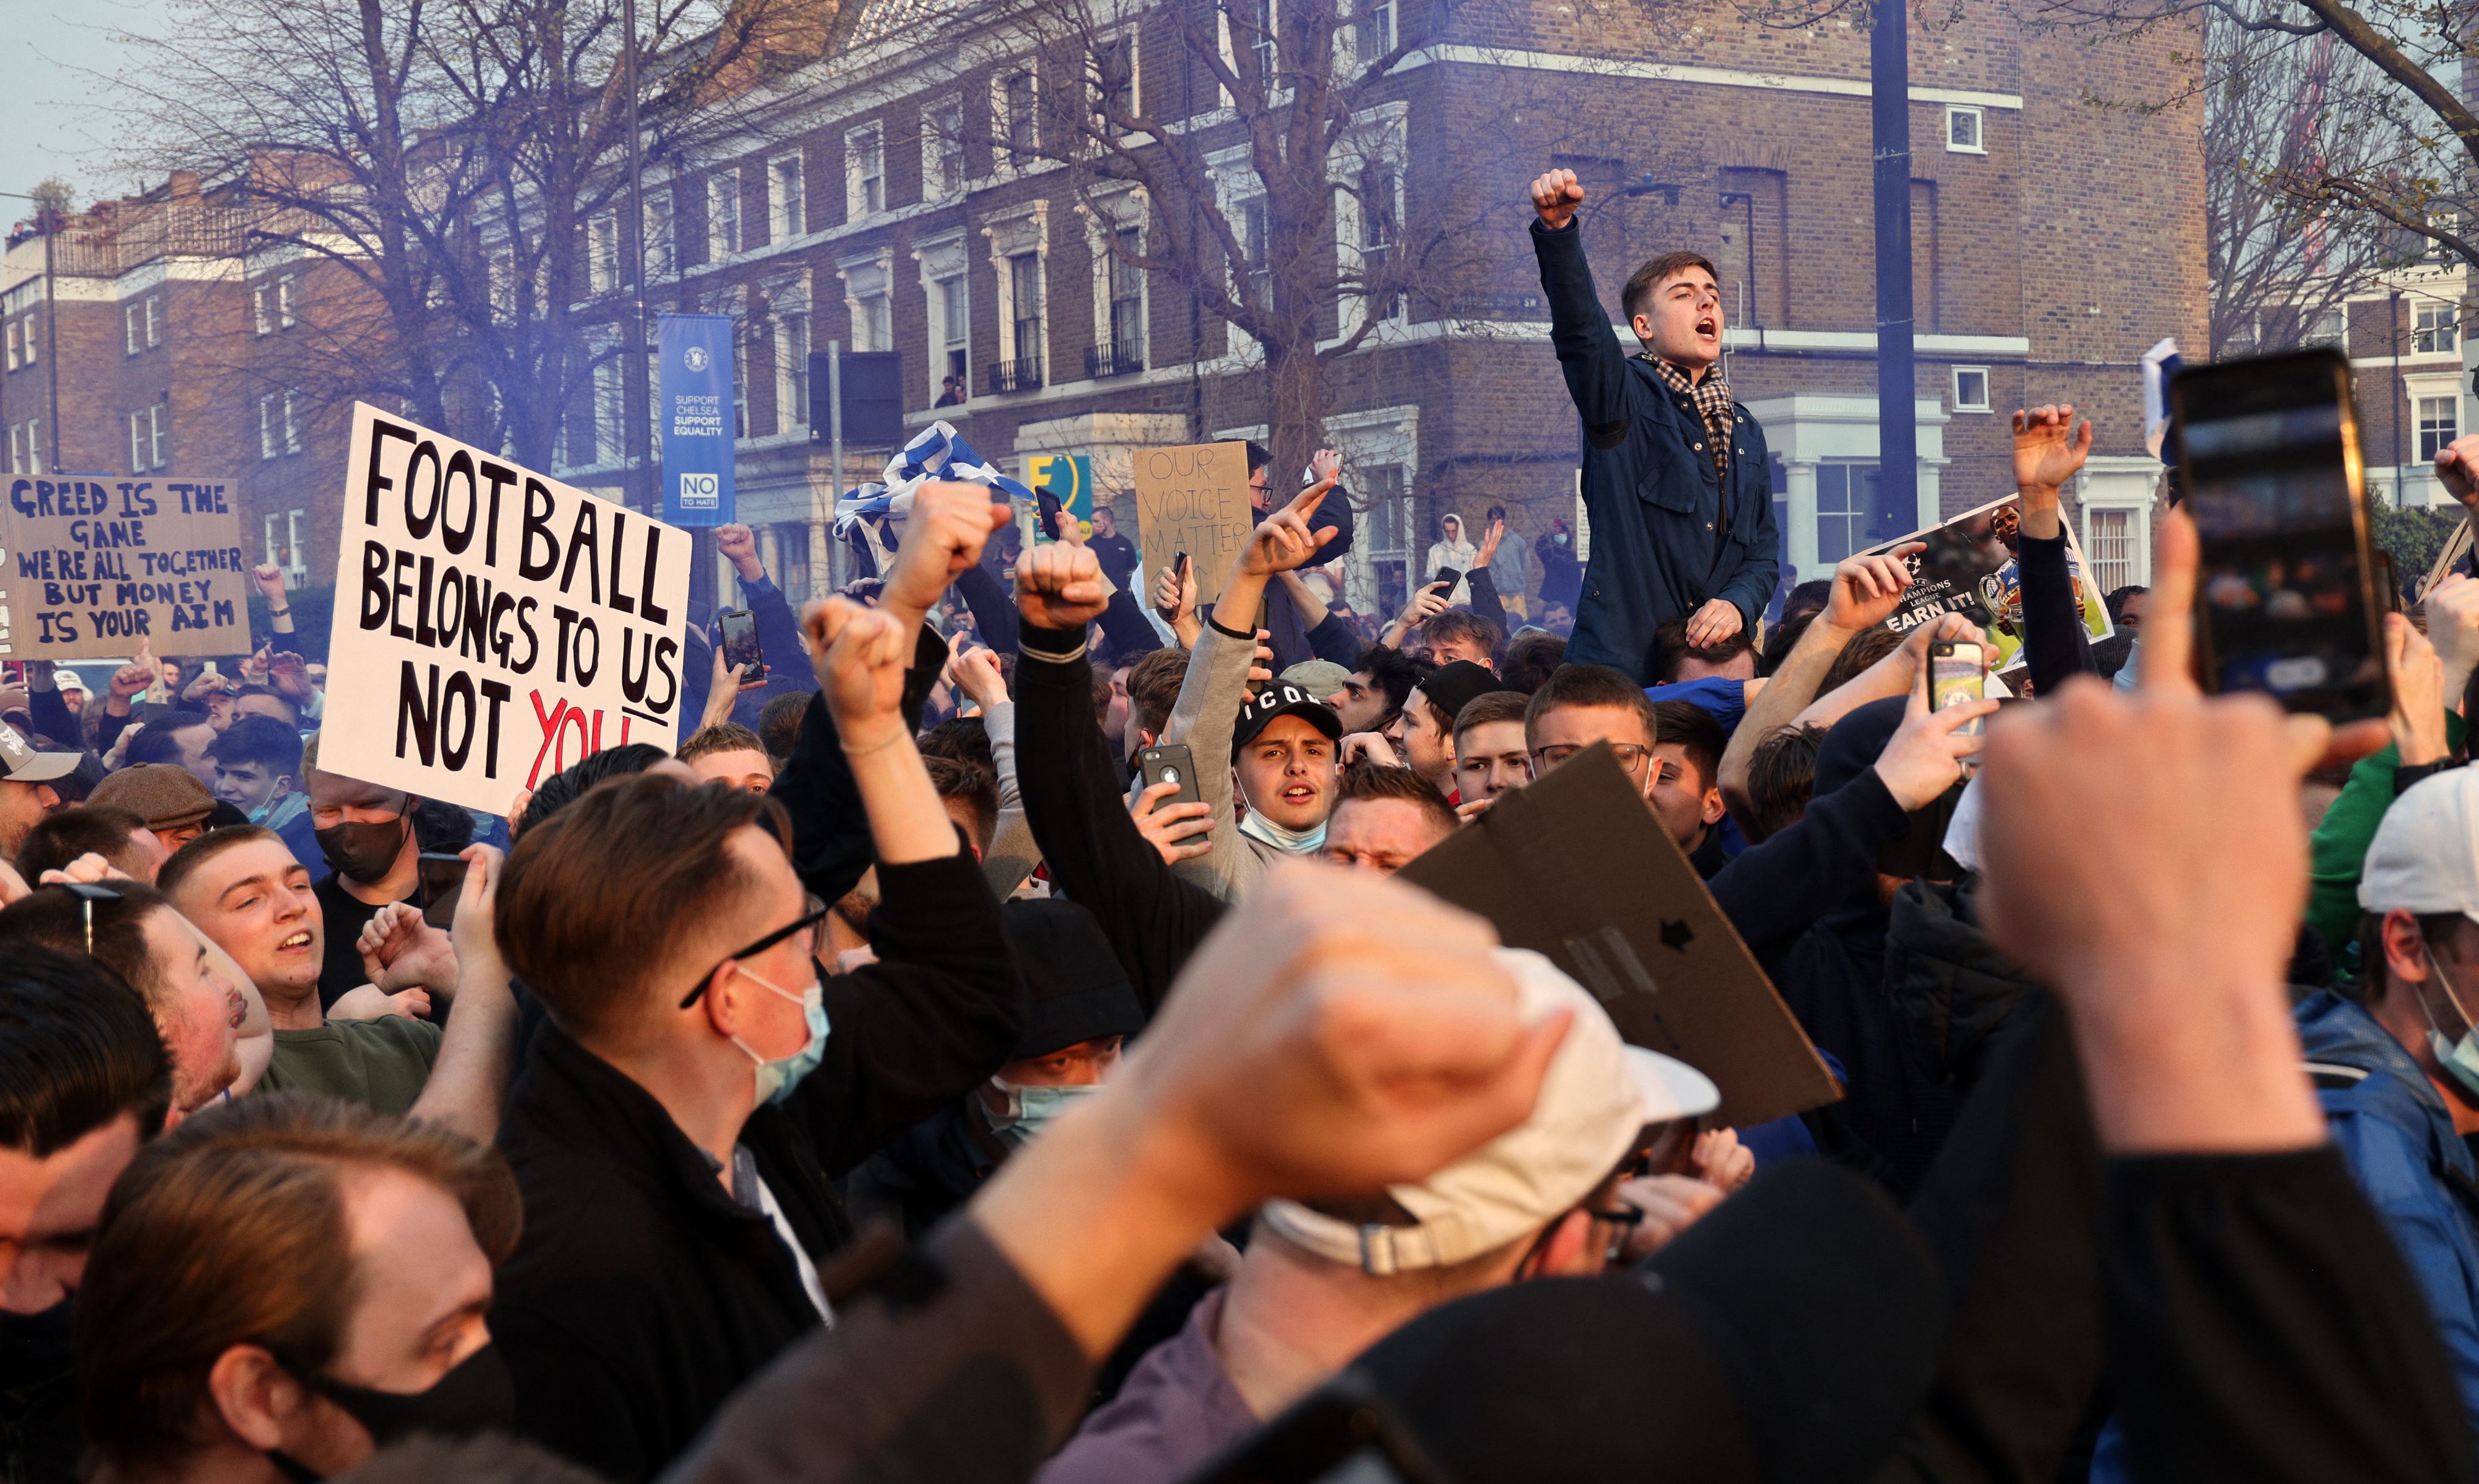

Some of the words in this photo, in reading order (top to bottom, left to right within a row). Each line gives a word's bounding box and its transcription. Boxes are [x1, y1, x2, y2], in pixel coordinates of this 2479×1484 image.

[675, 395, 719, 405] SUPPORT
[676, 406, 719, 415] CHELSEA
[674, 416, 721, 426] SUPPORT
[674, 426, 723, 436] EQUALITY
[1149, 449, 1214, 480] OUR
[10, 479, 108, 518] GREED
[117, 482, 157, 518] IS
[167, 483, 229, 514] THE
[684, 476, 715, 494] NO
[1142, 488, 1232, 523] VOICE
[70, 519, 146, 550] GAME
[365, 418, 667, 625] FOOTBALL
[17, 545, 87, 580] WE'RE
[93, 551, 131, 581] ALL
[138, 547, 244, 577] TOGETHER
[44, 582, 102, 606] BUT
[116, 579, 211, 606] MONEY
[1900, 579, 1951, 603] HAMPIONS
[1909, 592, 1941, 607] LEAGUE
[37, 611, 78, 643] IS
[87, 608, 151, 638] YOUR
[171, 599, 235, 632] AIM
[359, 540, 538, 675] BELONGS
[553, 604, 599, 687] TO
[622, 627, 678, 714] US
[1885, 600, 1945, 633] EARN
[1945, 591, 1975, 610] IT!
[395, 660, 511, 779] NOT
